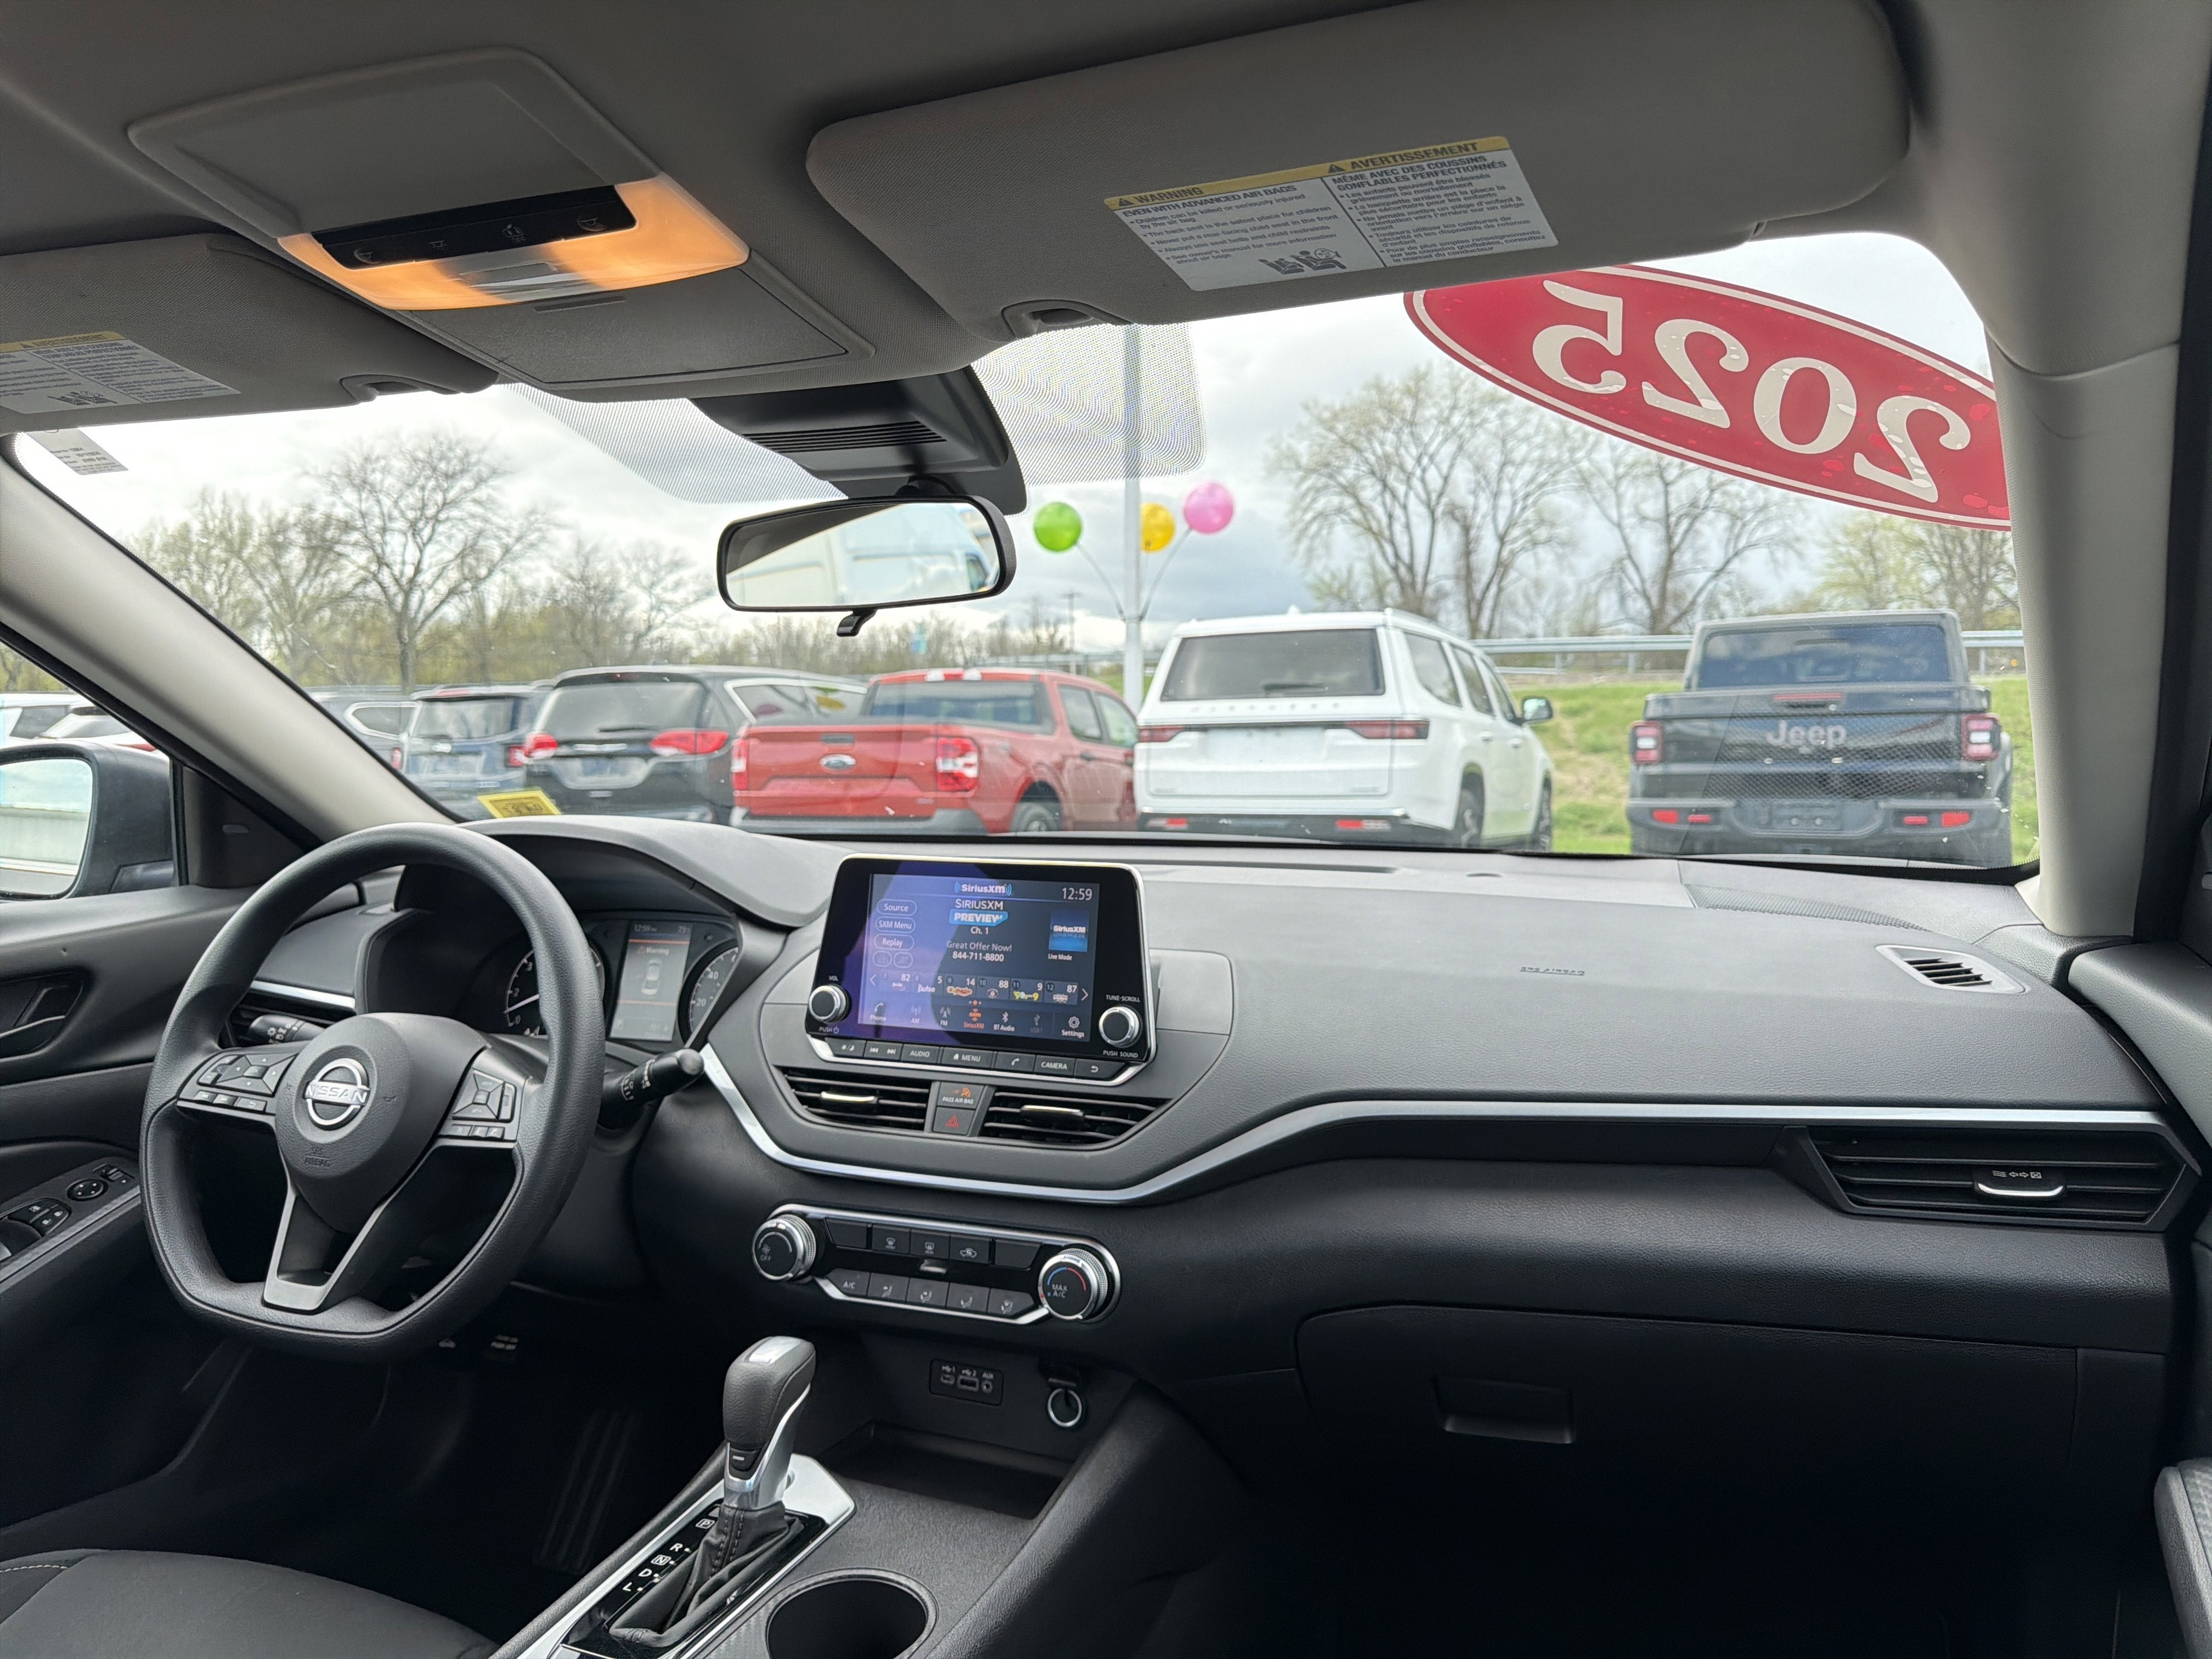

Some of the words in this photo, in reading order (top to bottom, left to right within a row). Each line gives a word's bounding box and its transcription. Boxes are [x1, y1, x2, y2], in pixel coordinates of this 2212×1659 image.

[1351, 142, 1477, 170] AVERTISSEMENT
[1331, 173, 1368, 184] MÊME
[1369, 168, 1400, 179] AVEC
[1401, 164, 1426, 173] DES
[1426, 155, 1487, 170] COUSSINS
[1337, 175, 1410, 191] GONFLABLES
[1411, 160, 1507, 180] PERFECTIONNÉS
[1133, 187, 1204, 203] WARNING
[1122, 207, 1152, 217] EVEN
[1151, 203, 1182, 212] WITH
[1182, 194, 1241, 208] ADVANCED
[1243, 190, 1263, 199] AIR
[1263, 185, 1297, 196] BAGS
[1135, 215, 1169, 224] Children
[1234, 199, 1274, 210] seriously
[1274, 194, 1306, 204] injured
[1764, 719, 1847, 751] Jeep
[1062, 887, 1092, 901] 12:59
[884, 903, 909, 912] Source
[955, 899, 1004, 911] SIRIUSXM
[953, 912, 1003, 923] PREVIEW
[879, 920, 893, 928] SXM
[894, 921, 912, 930] Menu
[970, 926, 983, 935] Ch.
[882, 938, 903, 948] Replay
[946, 940, 968, 950] Great
[969, 941, 990, 951] Offer
[992, 943, 1013, 952] Now!
[952, 950, 1005, 963] 844-711-8800
[901, 973, 911, 982] 82
[938, 975, 943, 984] 5
[966, 978, 975, 986] 14
[998, 979, 1009, 989] 88
[1037, 983, 1042, 991] 9
[1066, 985, 1077, 993] 87
[1061, 1029, 1085, 1039] Settings
[910, 1050, 930, 1058] AUDIO
[961, 1054, 981, 1063] MENU
[1119, 1050, 1138, 1058] SOUND
[1041, 1061, 1068, 1070] CAMERA
[305, 1084, 368, 1103] NISSAN
[843, 1280, 856, 1289] A/C
[1052, 1283, 1068, 1292] MAX
[1052, 1290, 1066, 1299] A/C
[669, 1543, 684, 1552] R
[638, 1568, 652, 1577] D
[622, 1582, 633, 1592] L
